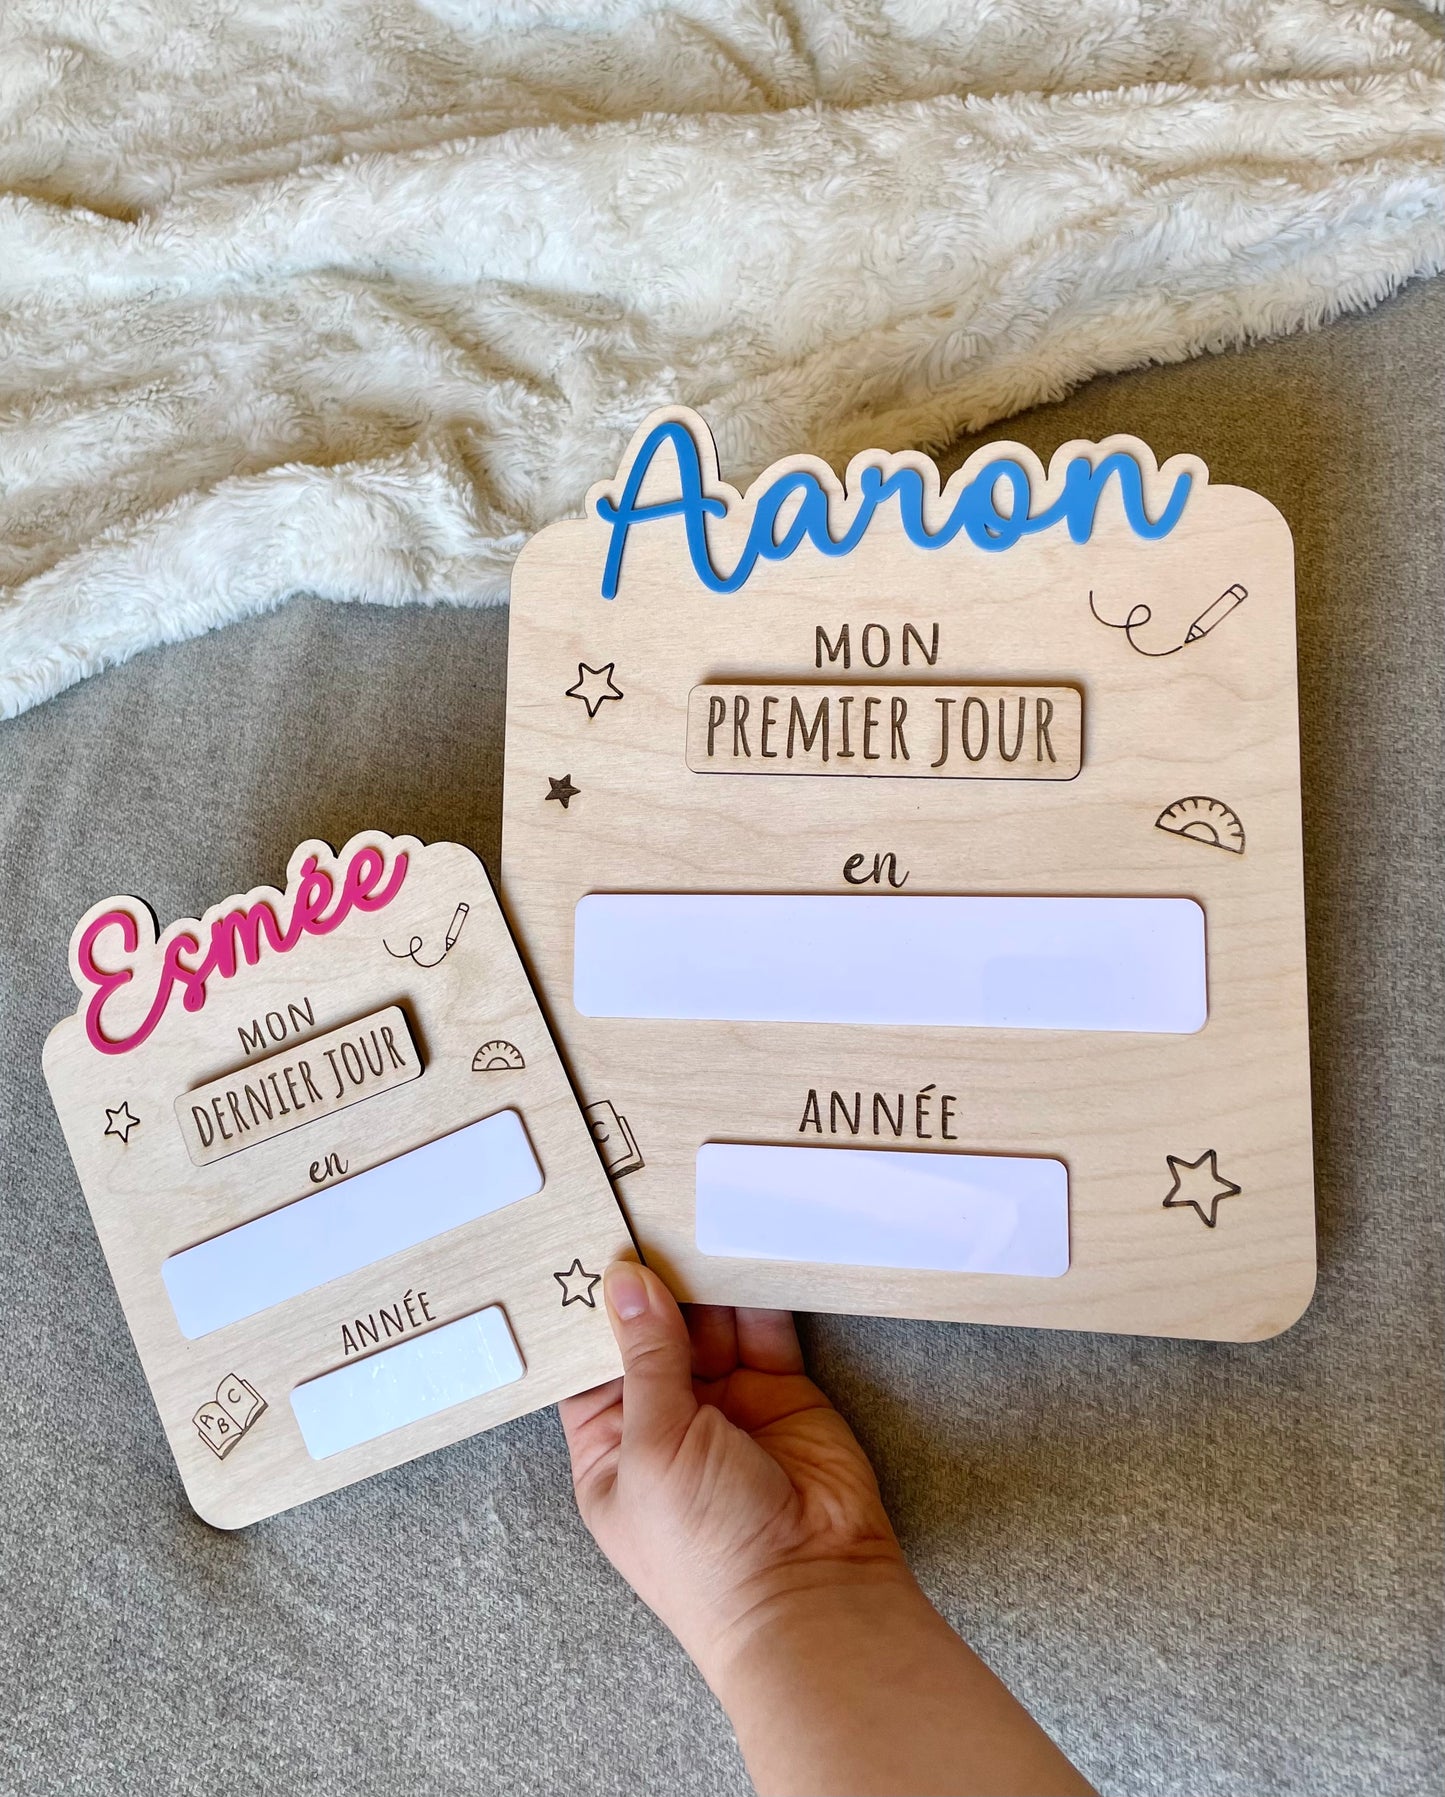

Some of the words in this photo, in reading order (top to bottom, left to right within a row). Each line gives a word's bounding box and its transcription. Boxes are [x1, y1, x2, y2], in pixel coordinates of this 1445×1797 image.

[595, 421, 1193, 600] Aaron
[815, 622, 940, 671] MON
[706, 694, 911, 763] PREMIER
[930, 695, 1058, 768] JOUR
[841, 851, 911, 890] en
[77, 846, 410, 1056] Esmée
[236, 996, 316, 1056] MON
[190, 1060, 324, 1149] DERNIER
[322, 1025, 407, 1100] JOUR
[797, 1082, 959, 1141] ANNÉE
[308, 1151, 350, 1185] en
[340, 1288, 438, 1357] ANNÉE
